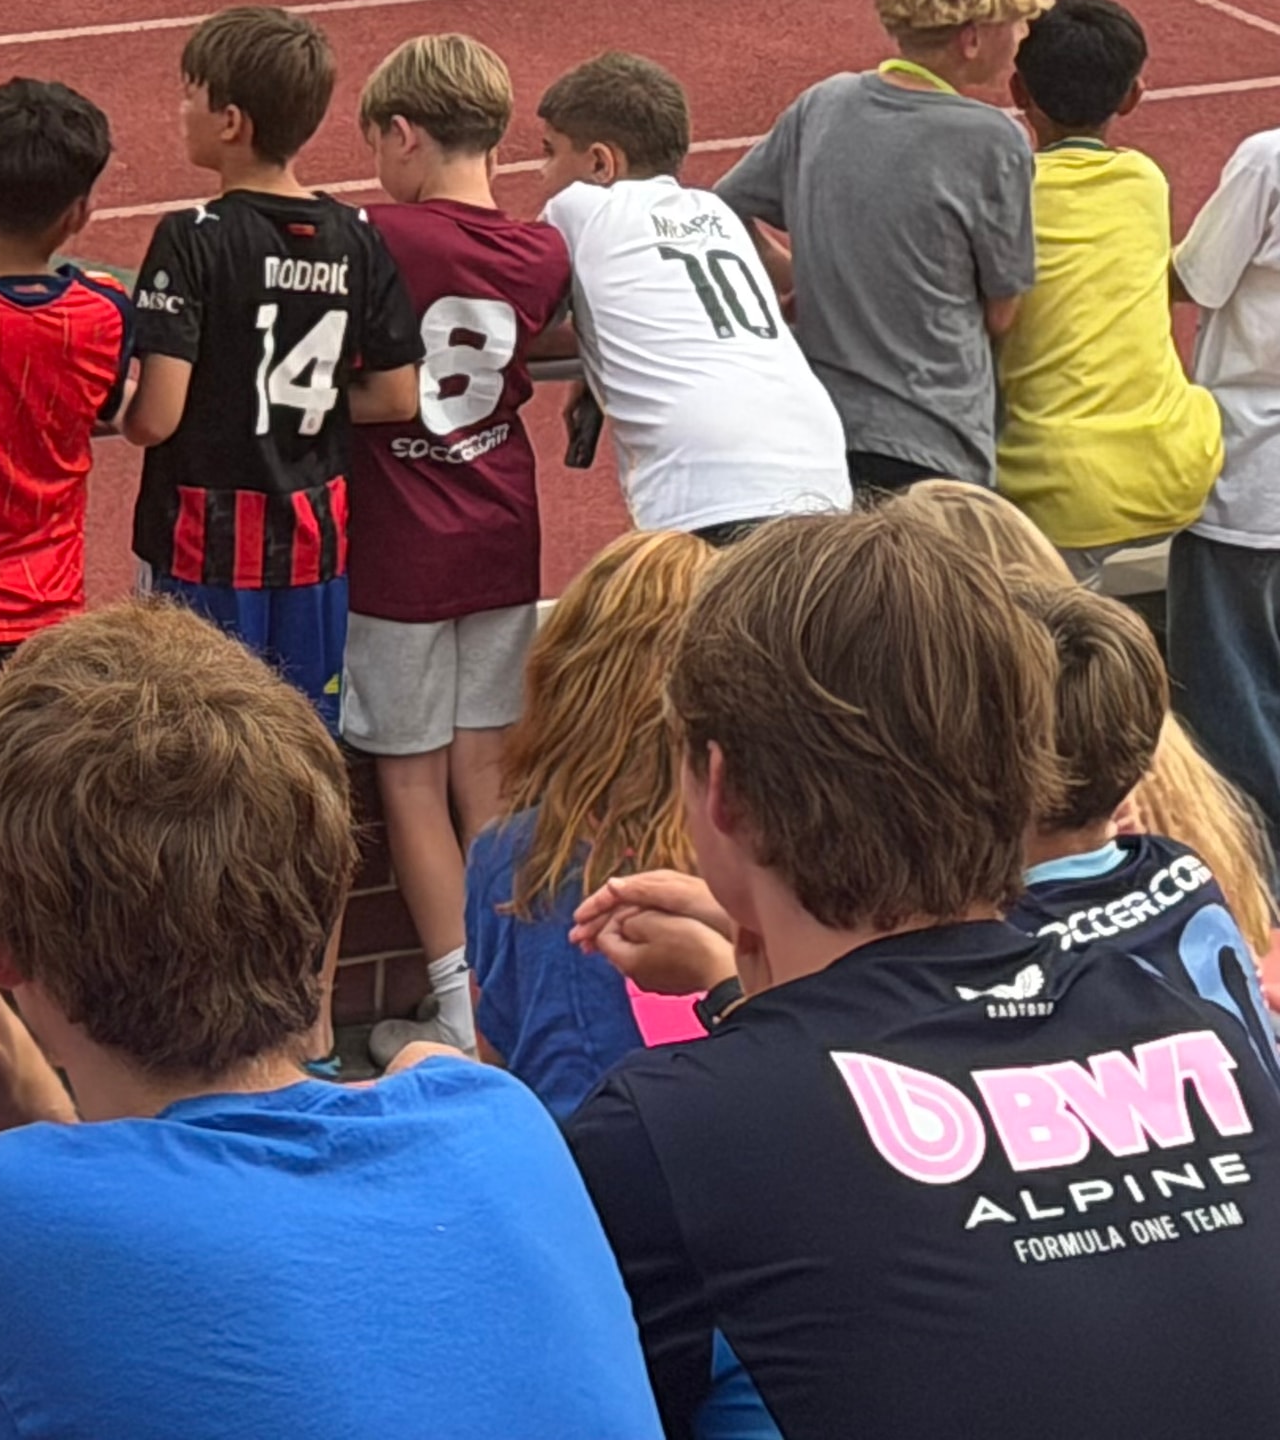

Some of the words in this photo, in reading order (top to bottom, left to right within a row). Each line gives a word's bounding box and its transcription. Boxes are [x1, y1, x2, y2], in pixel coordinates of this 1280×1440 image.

[137, 290, 184, 314] MSC
[657, 245, 778, 339] 10
[255, 303, 348, 435] 14
[420, 296, 516, 435] 8
[970, 1029, 1254, 1173] BWT
[964, 1153, 1251, 1230] ALPINE
[1013, 1226, 1127, 1264] FORMULA
[1131, 1215, 1180, 1245] ONE
[1181, 1201, 1244, 1234] TEAM
